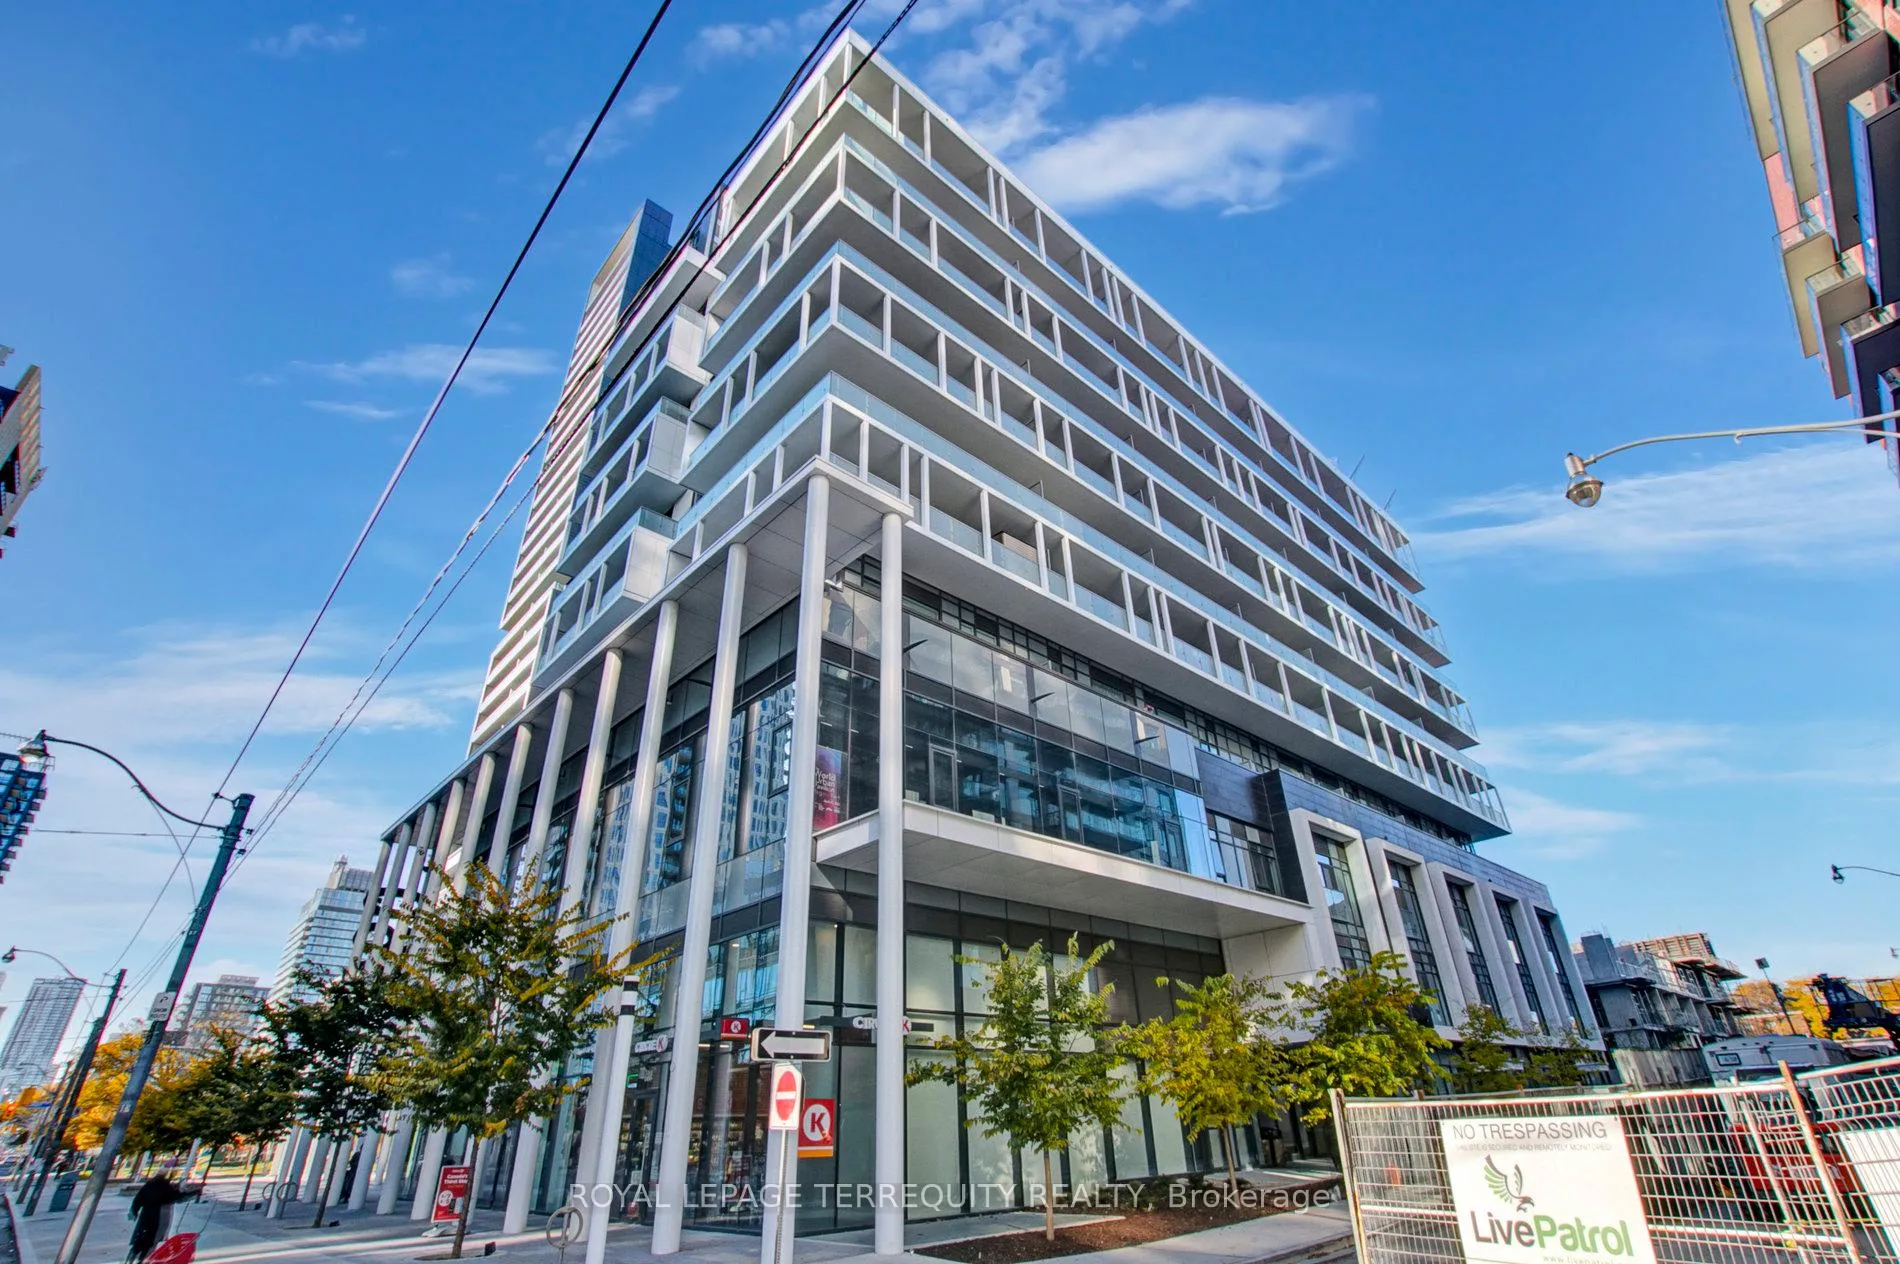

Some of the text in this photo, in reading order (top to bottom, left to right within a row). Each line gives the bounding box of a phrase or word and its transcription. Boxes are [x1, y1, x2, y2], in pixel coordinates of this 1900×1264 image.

[811, 1112, 827, 1138] K
[1453, 1121, 1608, 1140] NO TRESPASSING
[1470, 1211, 1634, 1256] LivePatrol
